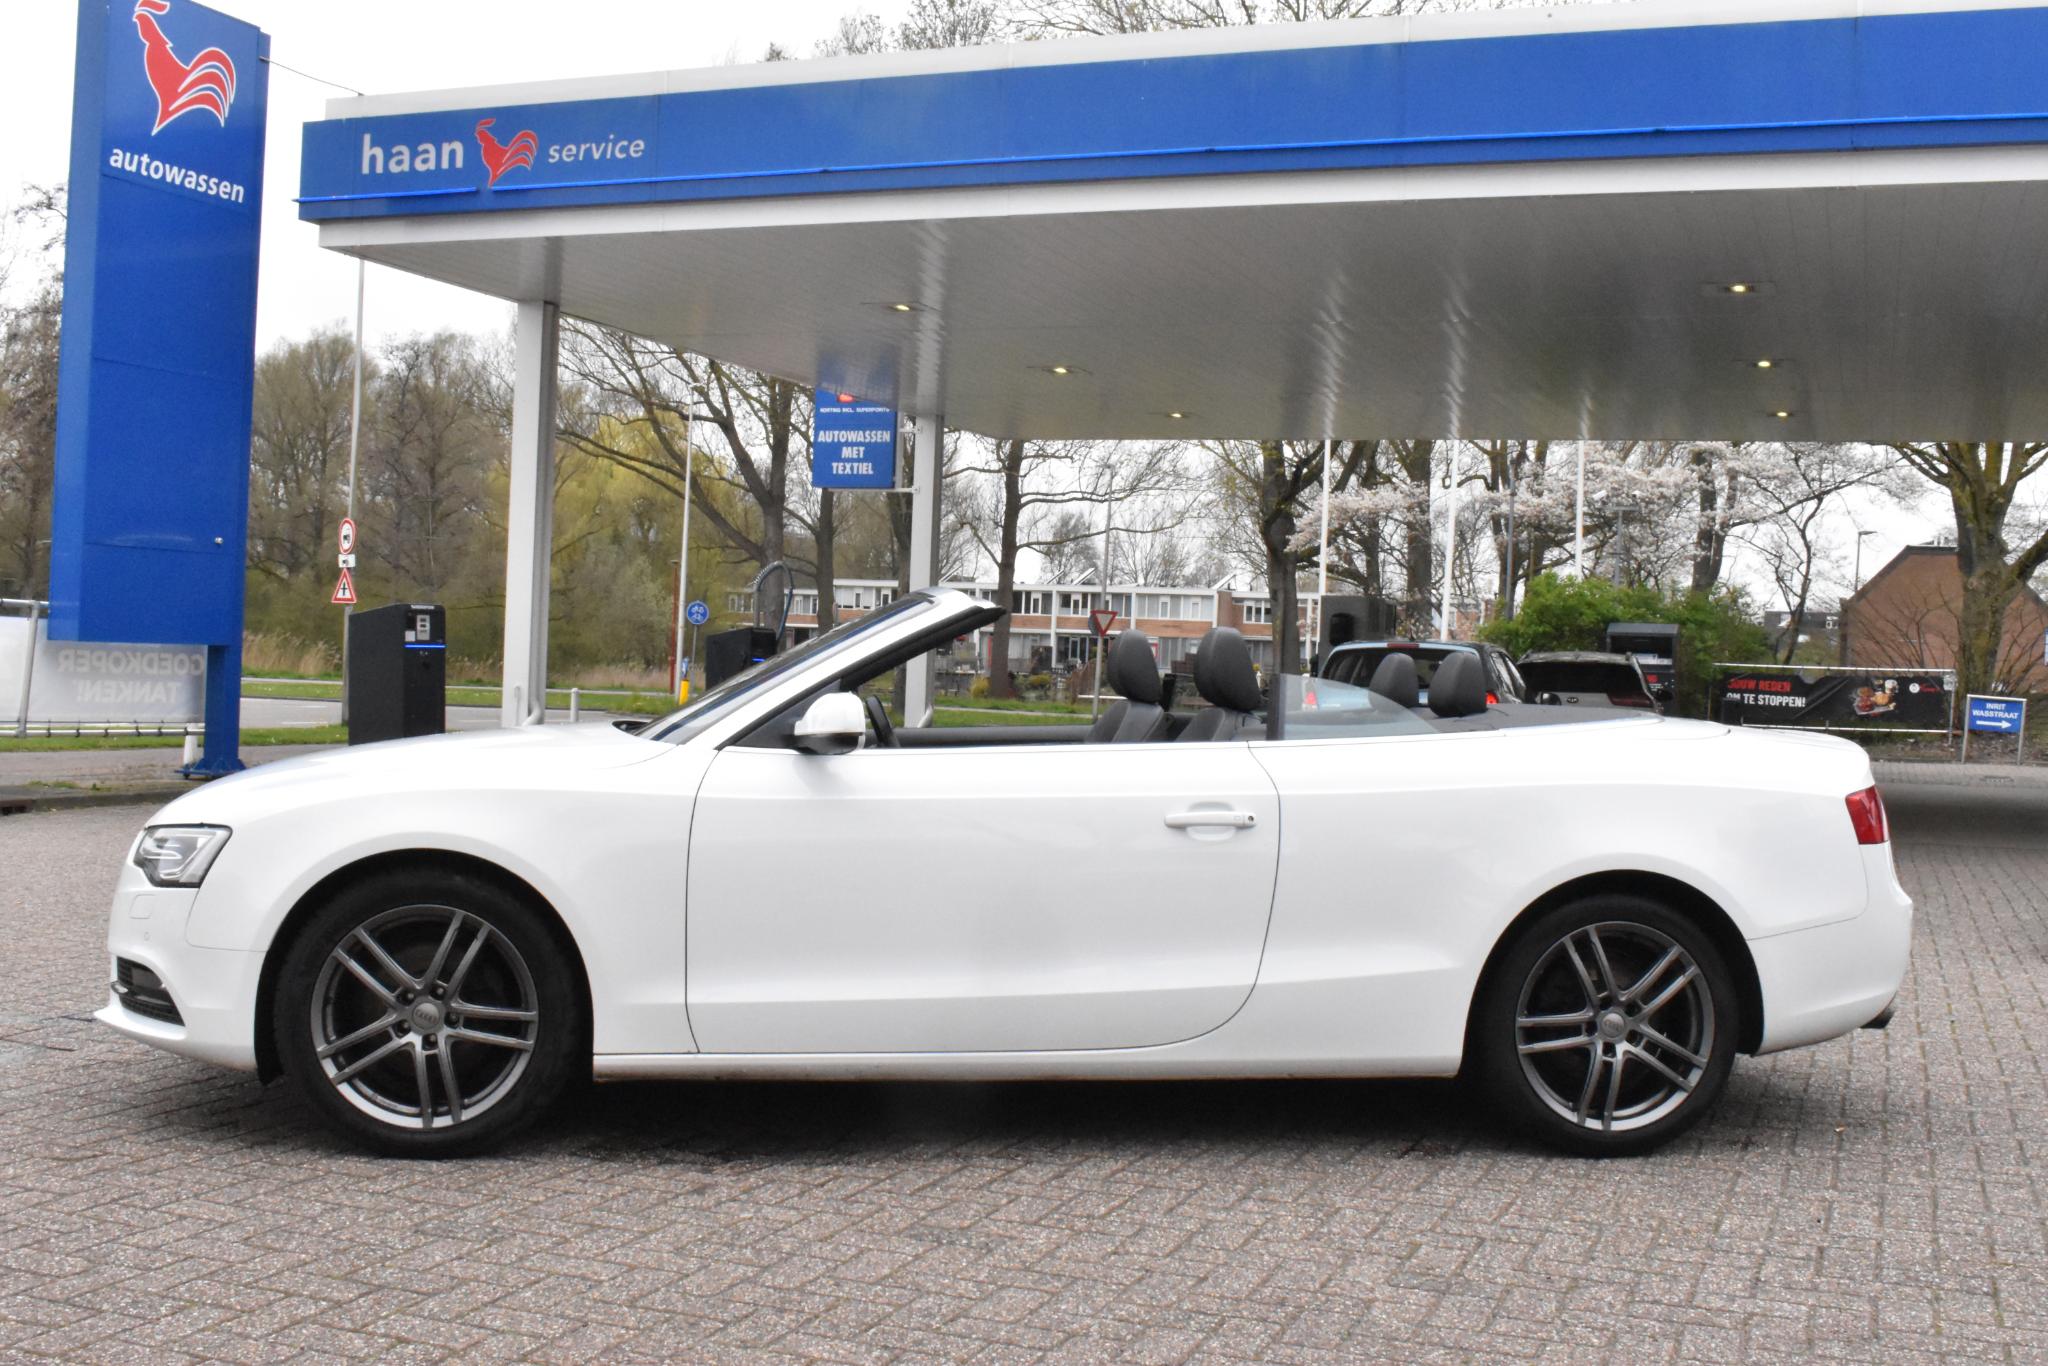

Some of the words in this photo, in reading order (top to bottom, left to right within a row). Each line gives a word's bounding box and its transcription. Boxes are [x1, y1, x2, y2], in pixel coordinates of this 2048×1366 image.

[361, 133, 464, 175] haan
[548, 134, 645, 163] service
[109, 148, 245, 204] autowassen
[817, 430, 891, 443] AUTOWASSEN
[841, 446, 865, 459] MET
[832, 462, 874, 475] TEXTIEL
[1743, 693, 1756, 705] TE
[1757, 694, 1806, 707] STOPPEN!
[1972, 709, 2019, 719] WASSTRAAT
